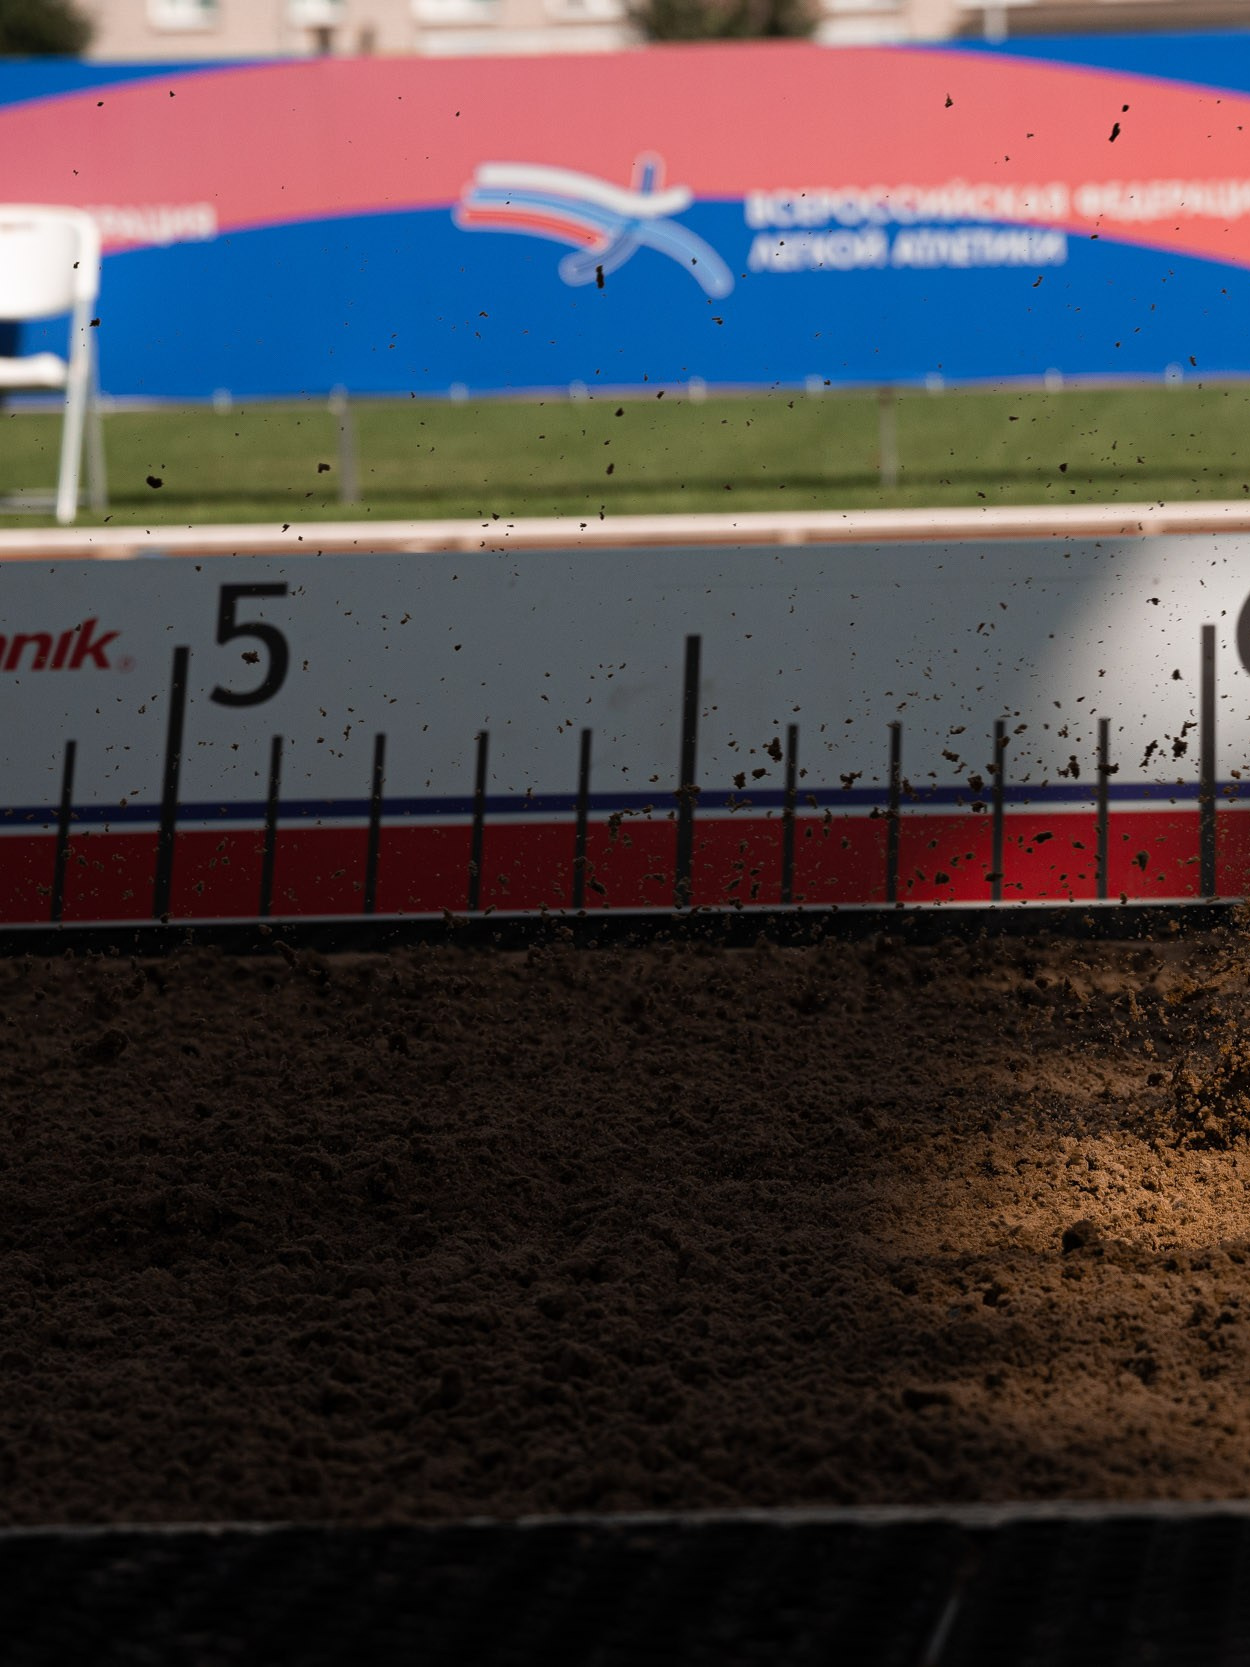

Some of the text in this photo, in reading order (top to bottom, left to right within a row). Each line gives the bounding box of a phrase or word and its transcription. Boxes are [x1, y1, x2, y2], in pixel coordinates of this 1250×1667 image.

[745, 178, 1071, 228] ВСЕРОССИЙСКАЯ
[893, 228, 1068, 268] АТЛЕТИКИ
[0, 617, 121, 671] nik
[209, 582, 289, 708] 5
